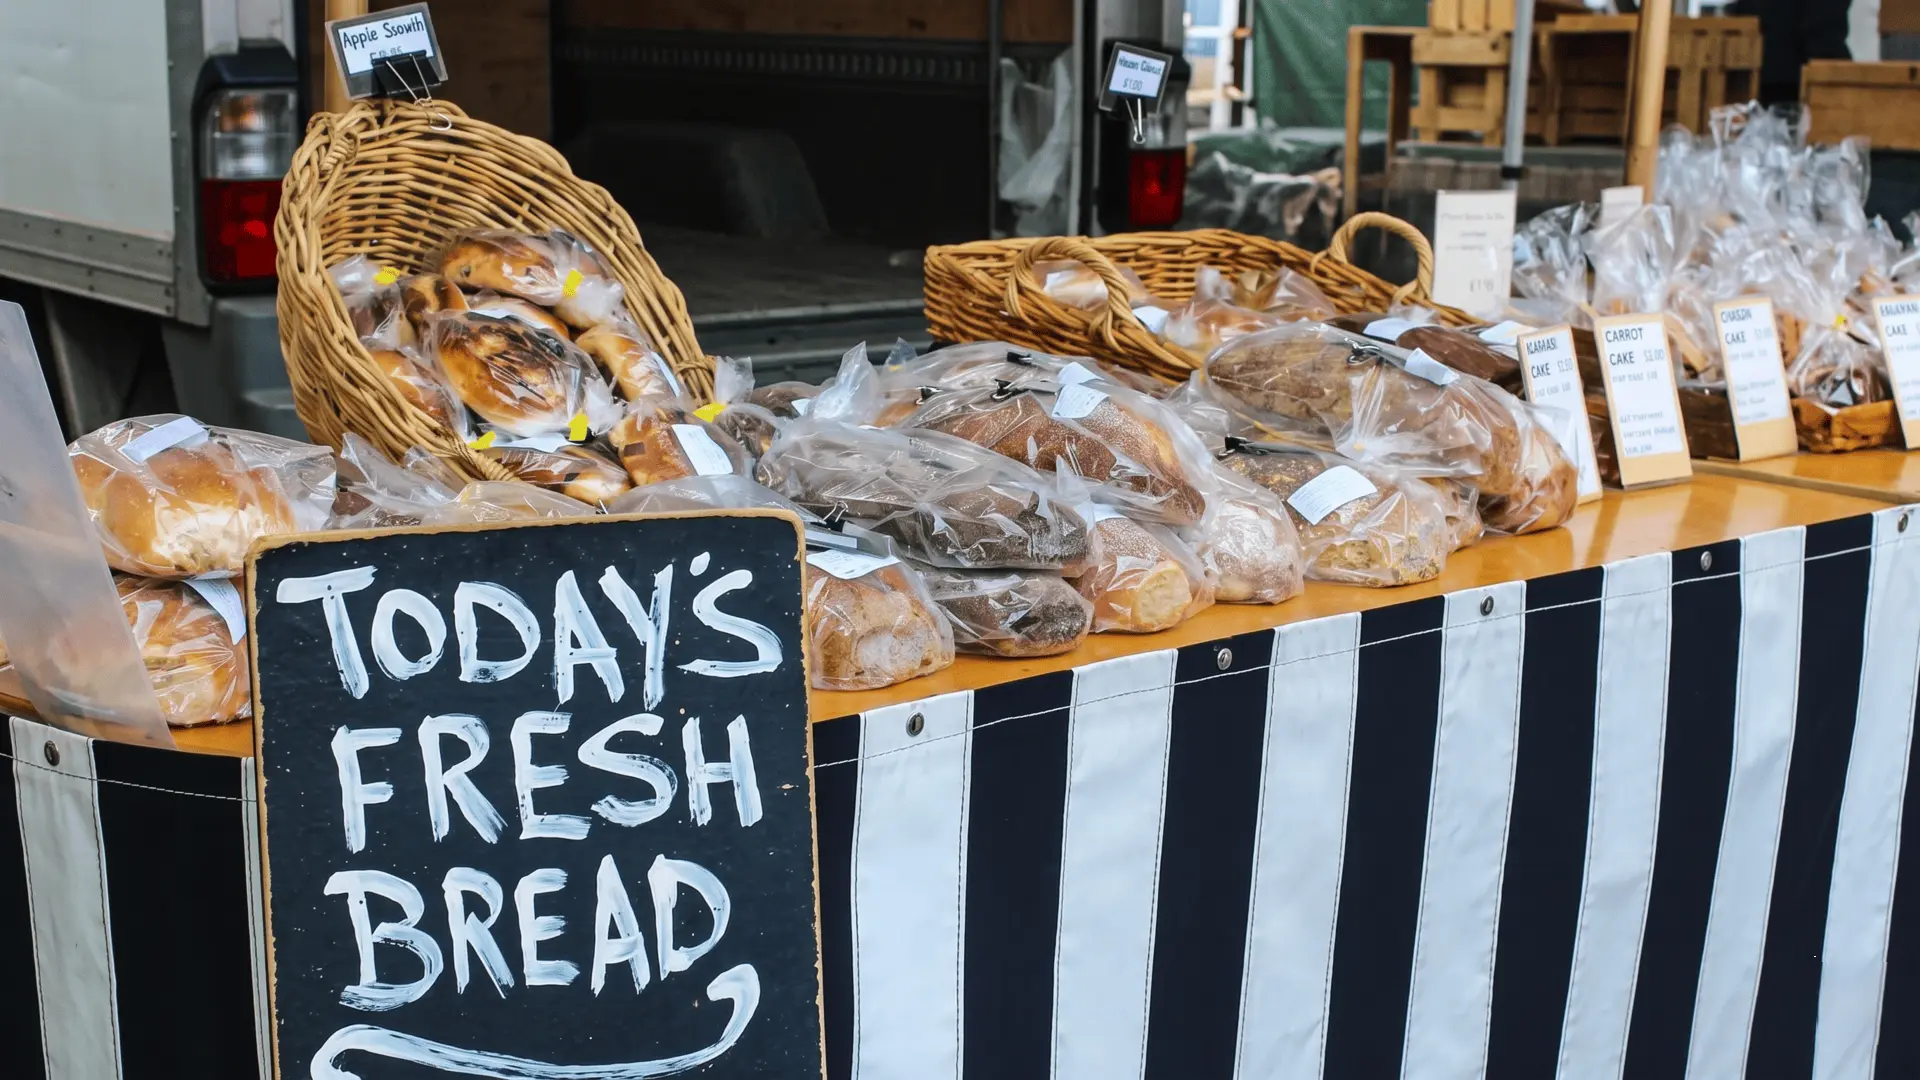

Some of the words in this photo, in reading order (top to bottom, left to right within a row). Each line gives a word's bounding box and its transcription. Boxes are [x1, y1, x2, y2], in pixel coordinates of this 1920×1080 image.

[1605, 328, 1643, 343] CARROT
[1725, 331, 1746, 345] CAKE
[1885, 324, 1908, 337] CAKE
[1609, 351, 1635, 366] CAKE
[1531, 362, 1551, 379] CAKE
[276, 552, 783, 711] TODAY'S
[330, 711, 763, 854] FRESH
[323, 854, 731, 1011] BREAD
